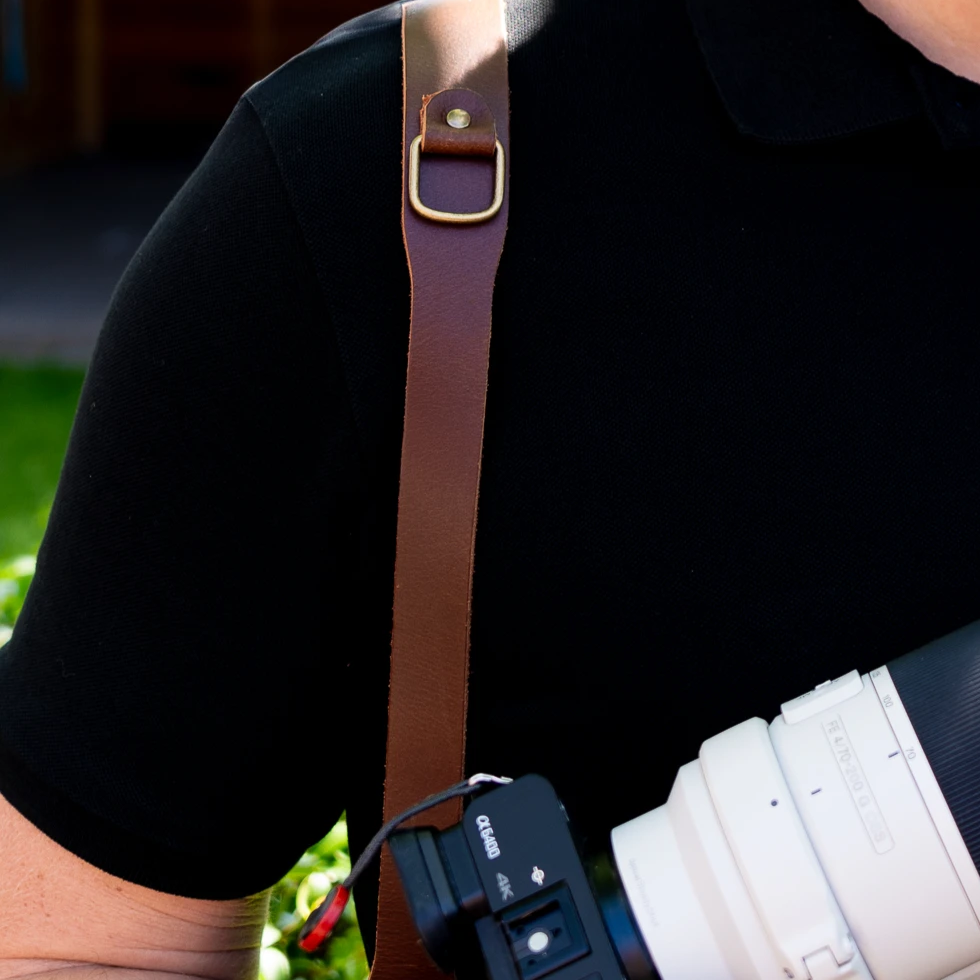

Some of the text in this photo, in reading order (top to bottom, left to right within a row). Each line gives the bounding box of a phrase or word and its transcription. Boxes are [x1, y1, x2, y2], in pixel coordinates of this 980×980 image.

[826, 719, 841, 734] FE
[904, 746, 917, 761] 70
[496, 872, 514, 901] 4K
